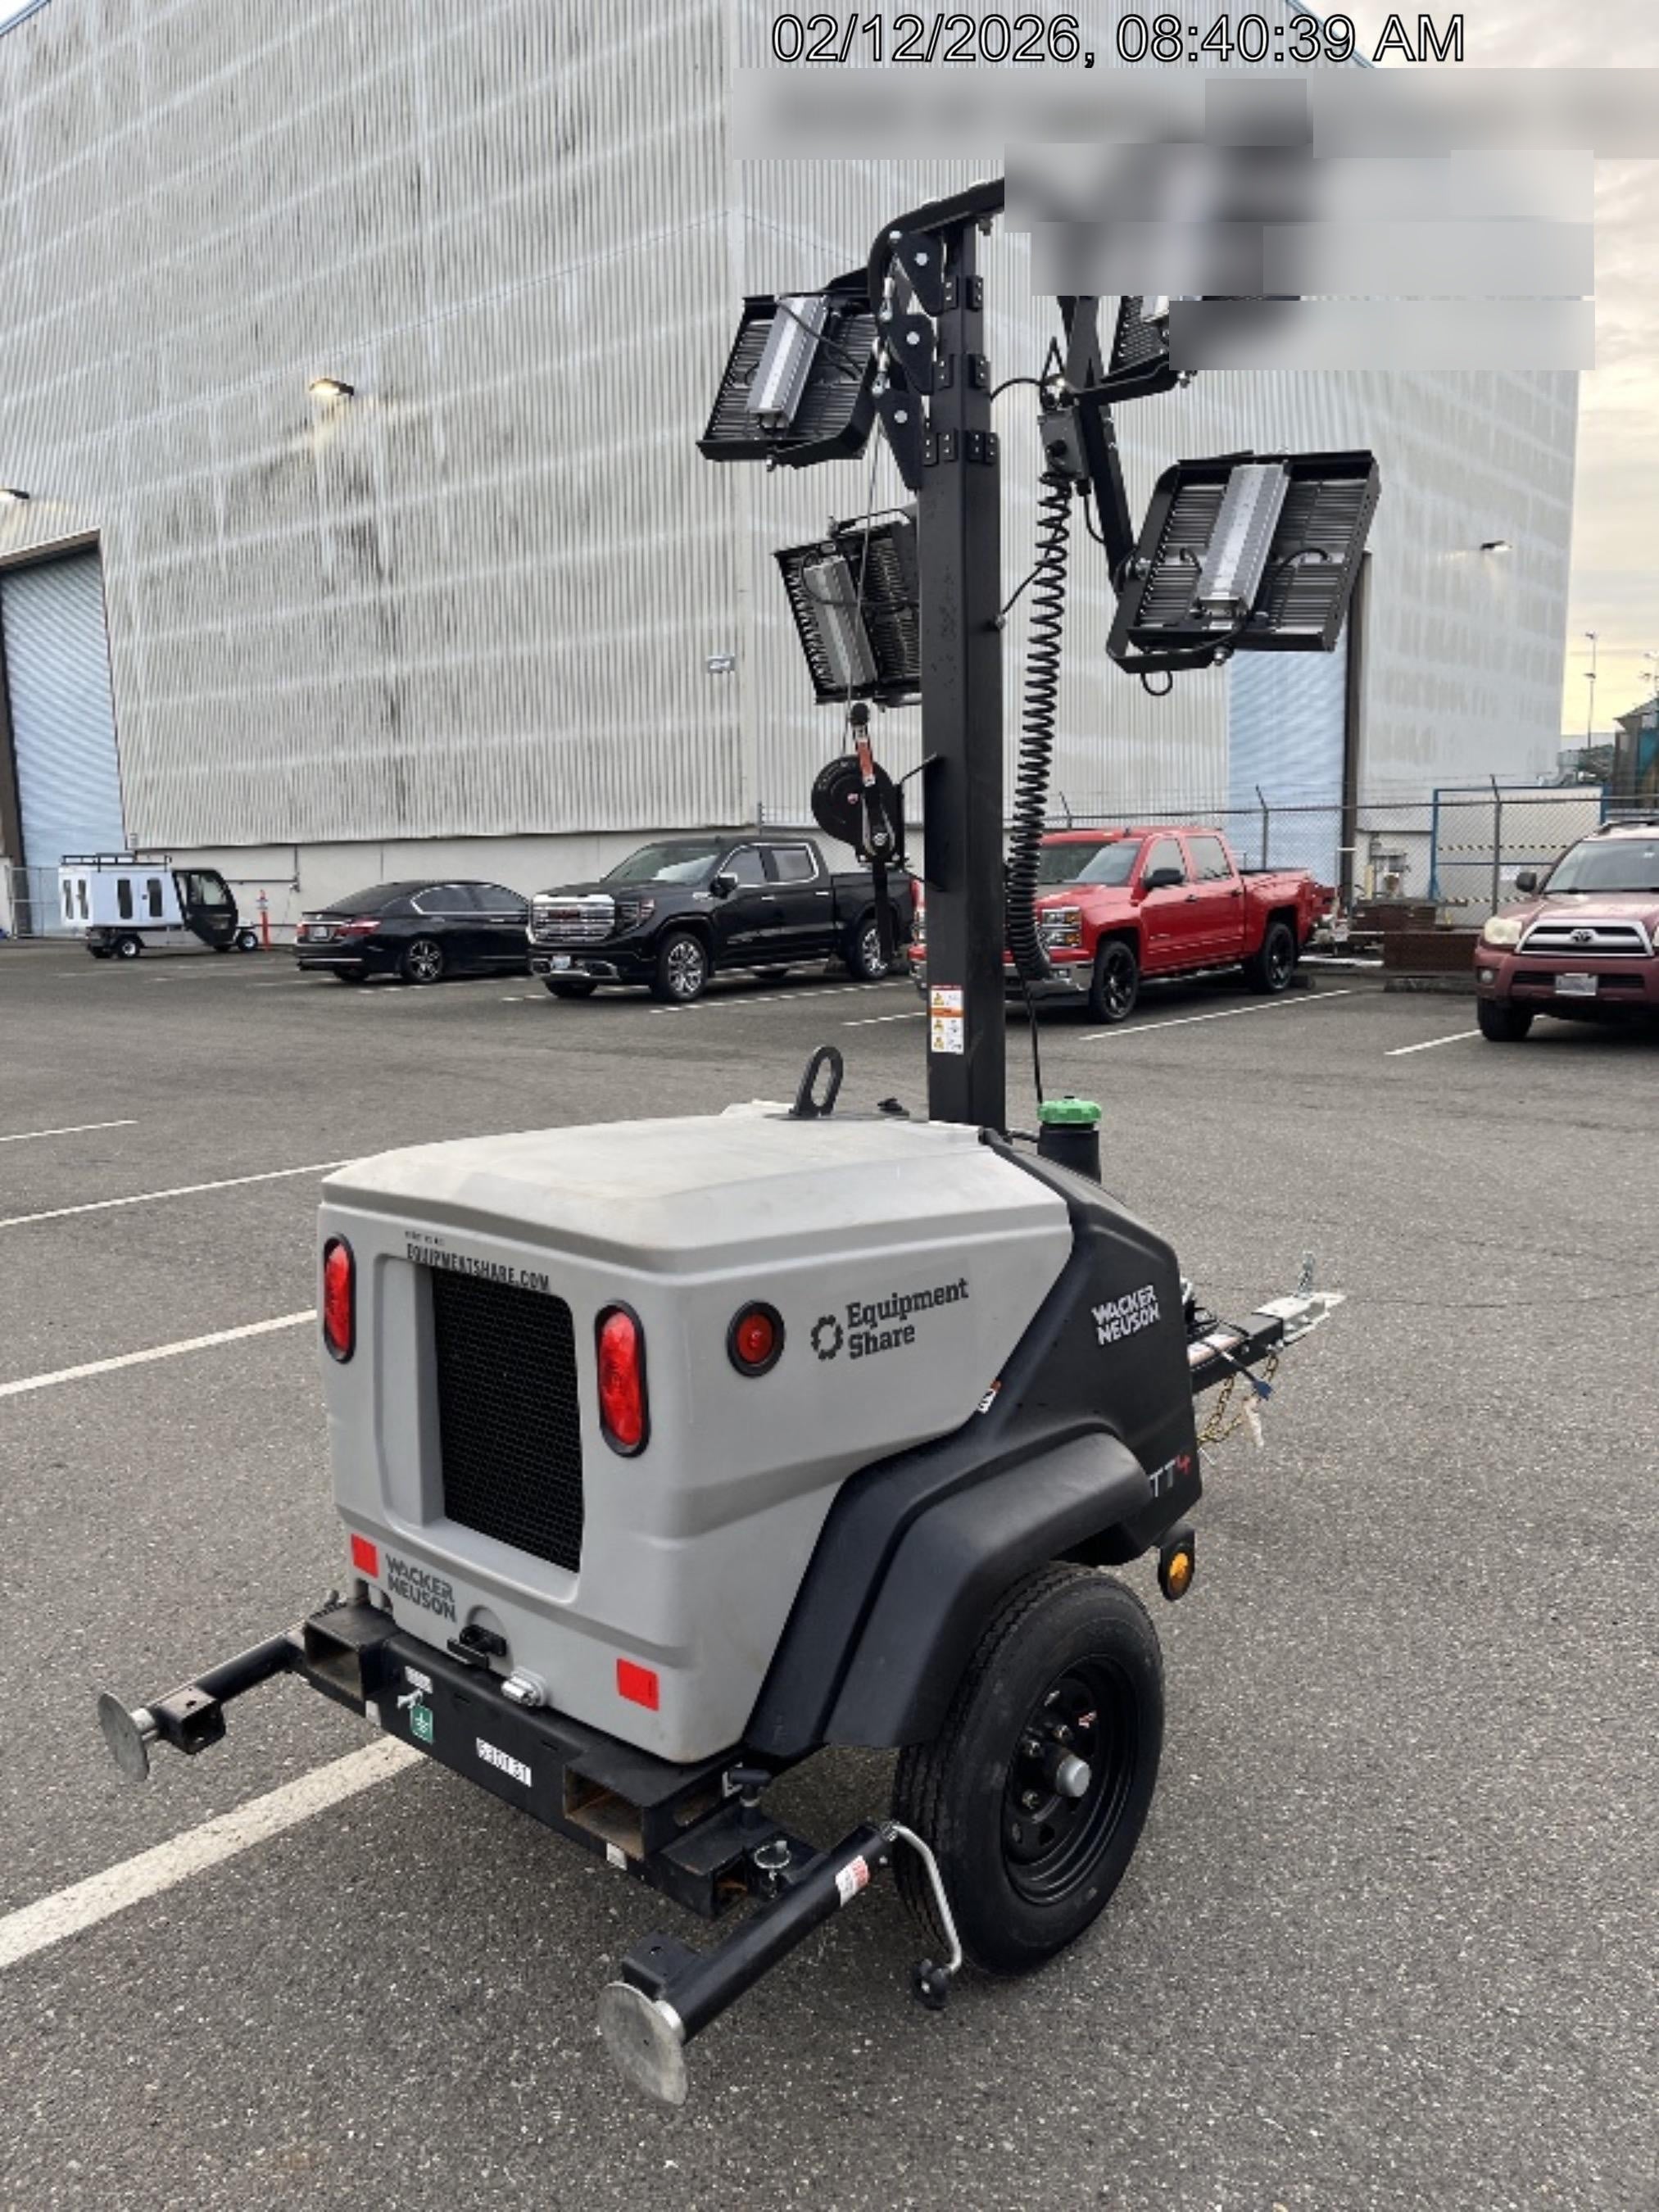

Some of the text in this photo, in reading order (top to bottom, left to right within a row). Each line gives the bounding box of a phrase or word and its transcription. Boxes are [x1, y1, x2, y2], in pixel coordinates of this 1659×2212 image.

[406, 1243, 550, 1292] EQUIPMENTSHARE.COM
[846, 1278, 969, 1329] Equipment
[1091, 1285, 1157, 1326] WACKER
[1097, 1303, 1161, 1345] NEUSON
[849, 1325, 915, 1359] Share
[385, 1552, 455, 1603] WACKER
[388, 1572, 457, 1623] NEUSON
